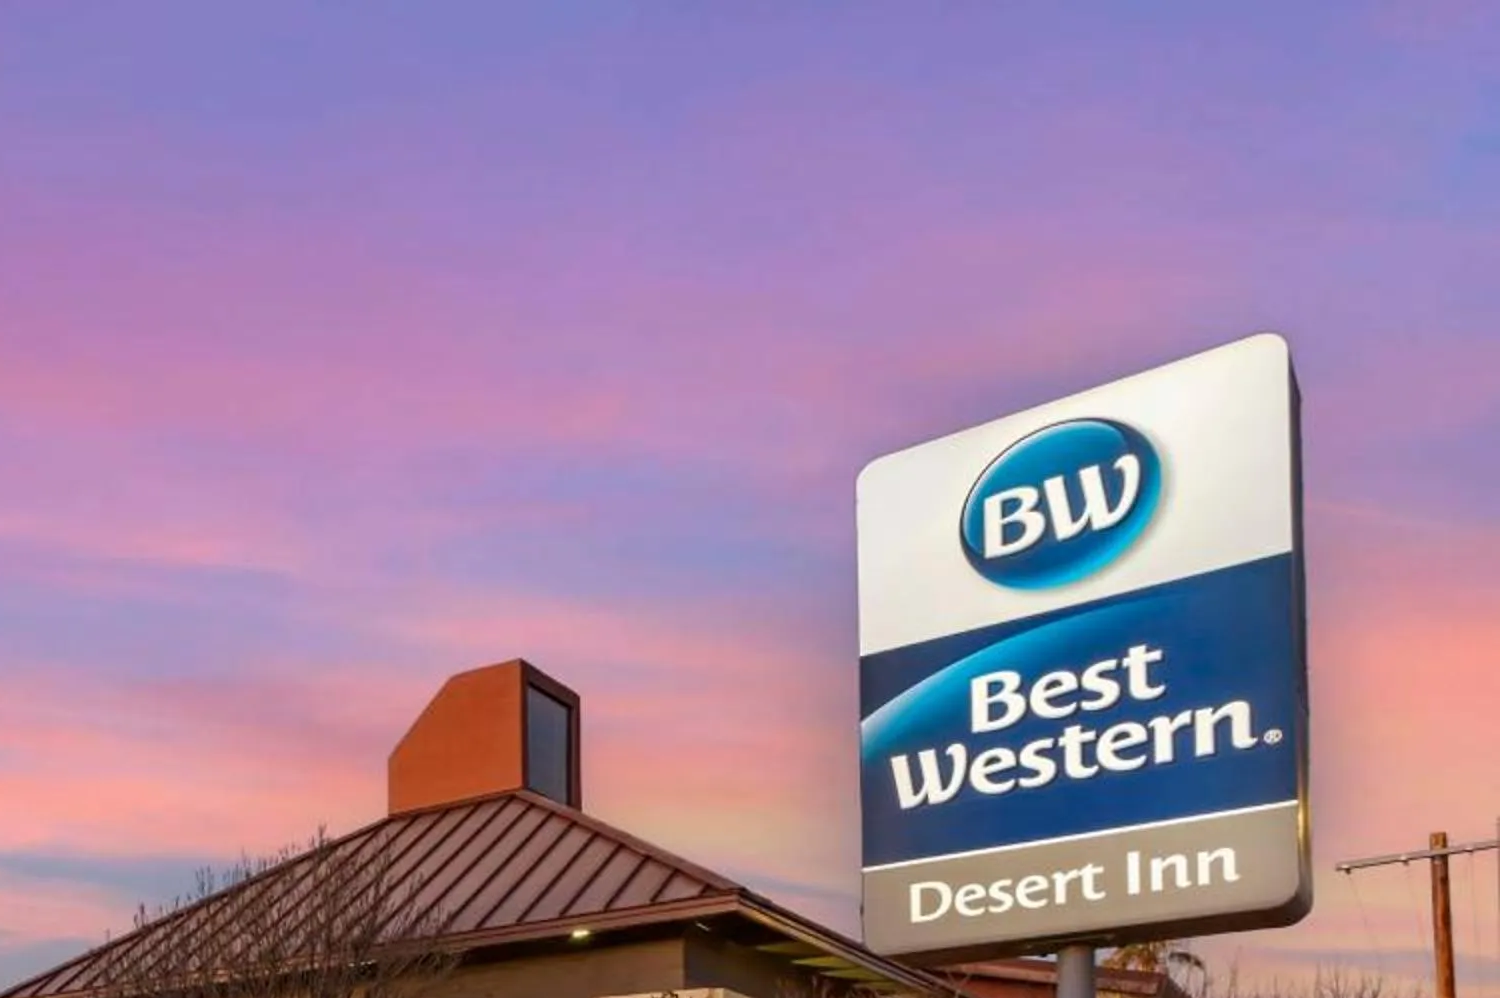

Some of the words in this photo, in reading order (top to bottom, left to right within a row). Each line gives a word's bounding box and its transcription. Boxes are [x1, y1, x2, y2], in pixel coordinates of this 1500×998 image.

[982, 453, 1140, 560] BW
[970, 643, 1166, 733] Best
[908, 862, 1106, 924] Desert
[1125, 846, 1241, 895] Inn
